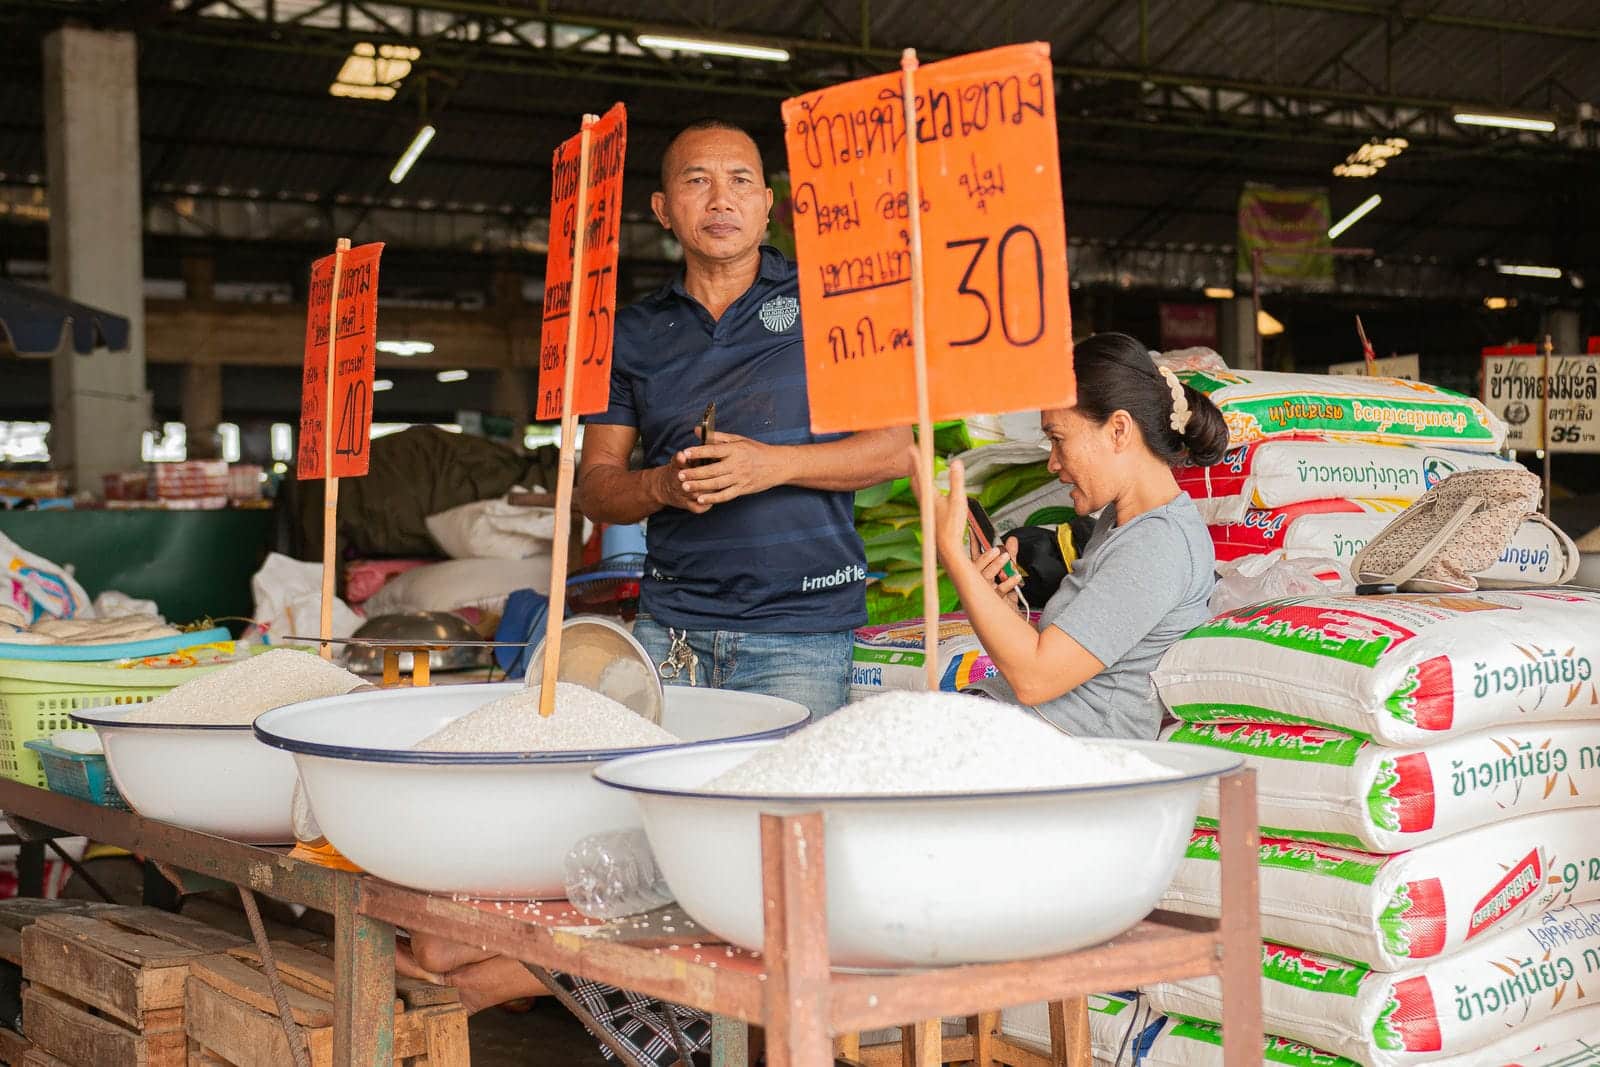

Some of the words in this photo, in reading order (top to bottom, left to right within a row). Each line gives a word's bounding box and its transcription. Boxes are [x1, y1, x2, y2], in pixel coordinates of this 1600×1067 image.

[946, 224, 1046, 346] 30
[336, 379, 367, 463] 40
[1298, 460, 1419, 490] ข้าวหอมทุ่งกุลา
[1473, 649, 1592, 699] ข้าวเหนียว
[1451, 741, 1568, 797] ข้าวเหนียว
[1454, 957, 1574, 1022] ข้าวเหนียว
